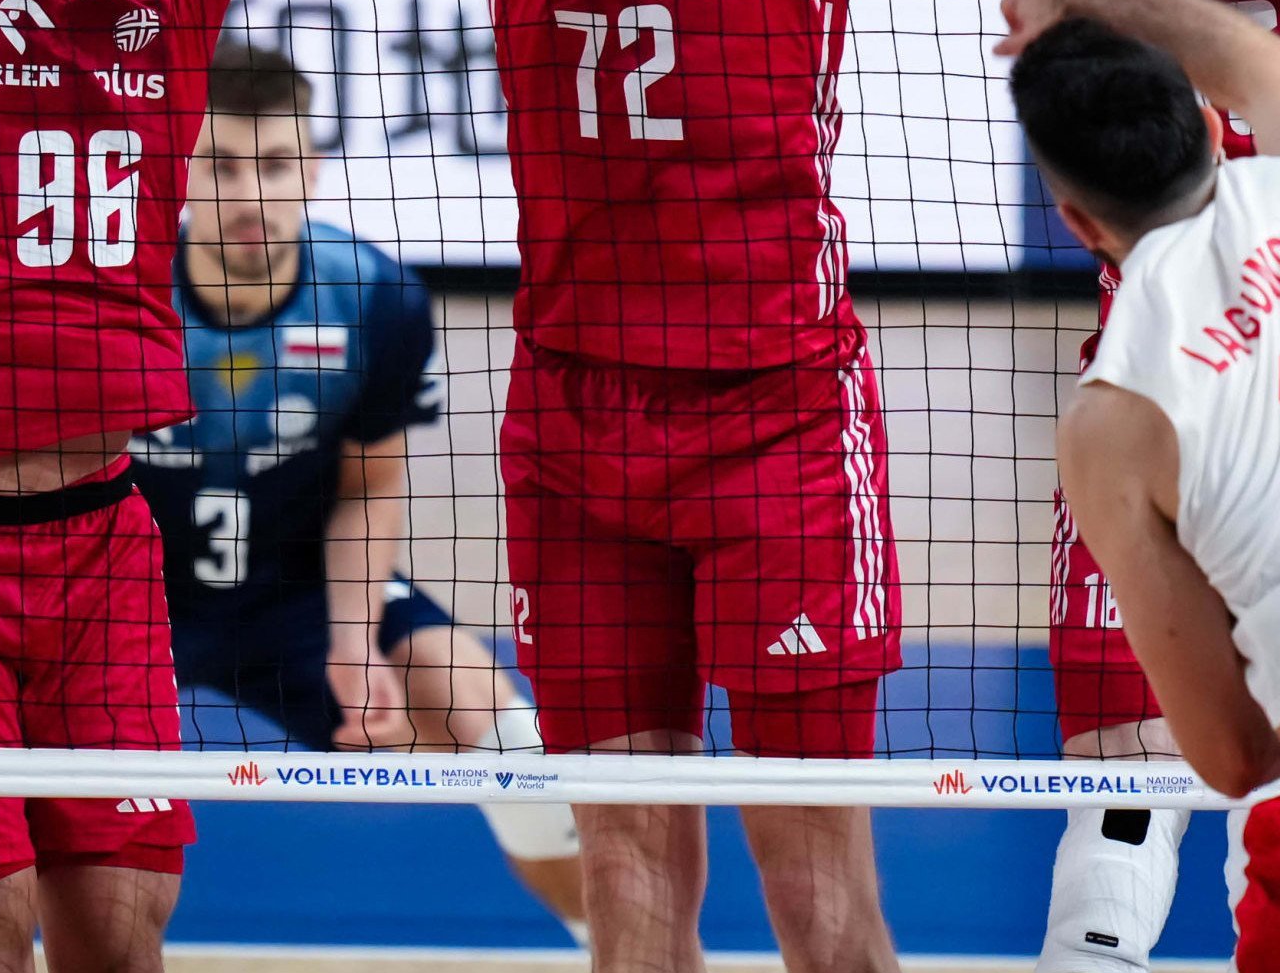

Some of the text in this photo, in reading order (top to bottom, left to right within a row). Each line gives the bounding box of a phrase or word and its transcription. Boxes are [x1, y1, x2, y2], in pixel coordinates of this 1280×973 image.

[554, 3, 684, 141] 72
[17, 130, 142, 267] 96
[194, 489, 251, 588] 3
[511, 588, 533, 645] 2
[276, 767, 436, 786] VOLLEYBALL
[441, 769, 488, 778] NATIONS
[441, 778, 483, 787] LEAGUE
[516, 773, 559, 783] Volleyball
[1146, 776, 1193, 785] NATIONS
[981, 775, 1141, 793] VOLLEYBALL
[1146, 785, 1188, 794] LEAGUE
